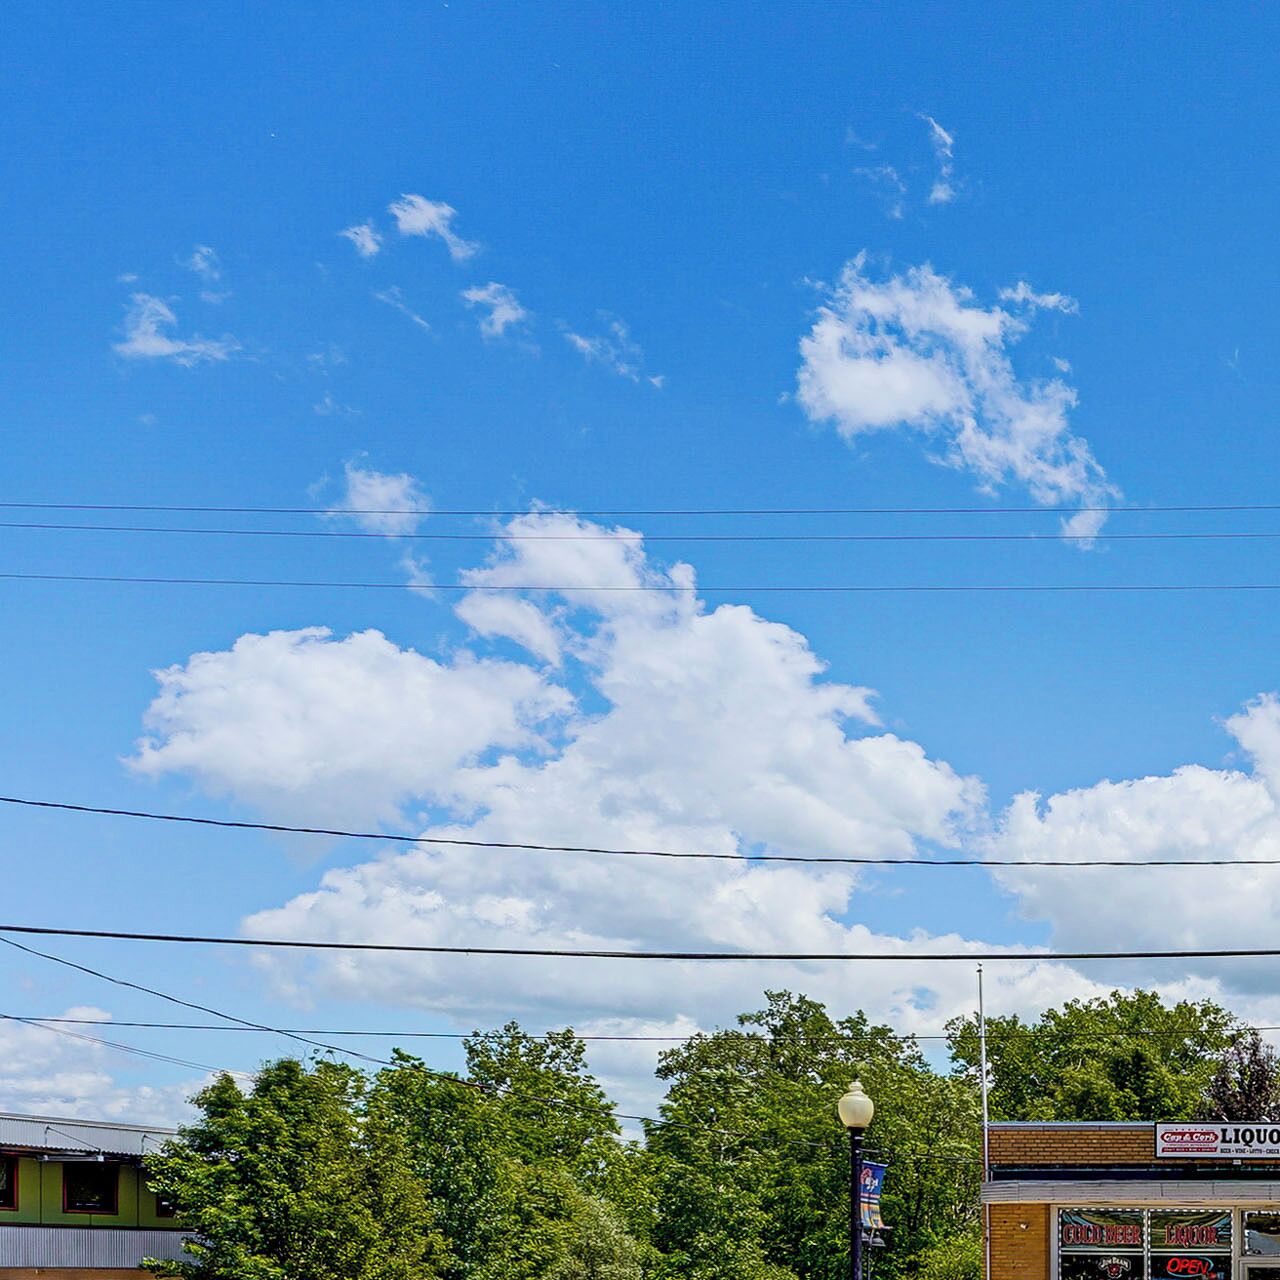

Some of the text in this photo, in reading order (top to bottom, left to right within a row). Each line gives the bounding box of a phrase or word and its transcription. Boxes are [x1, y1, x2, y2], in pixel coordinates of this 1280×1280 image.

[1063, 1224, 1141, 1244] COLD BEER
[1164, 1225, 1218, 1248] LIQUOR
[1167, 1257, 1208, 1274] OPEN
